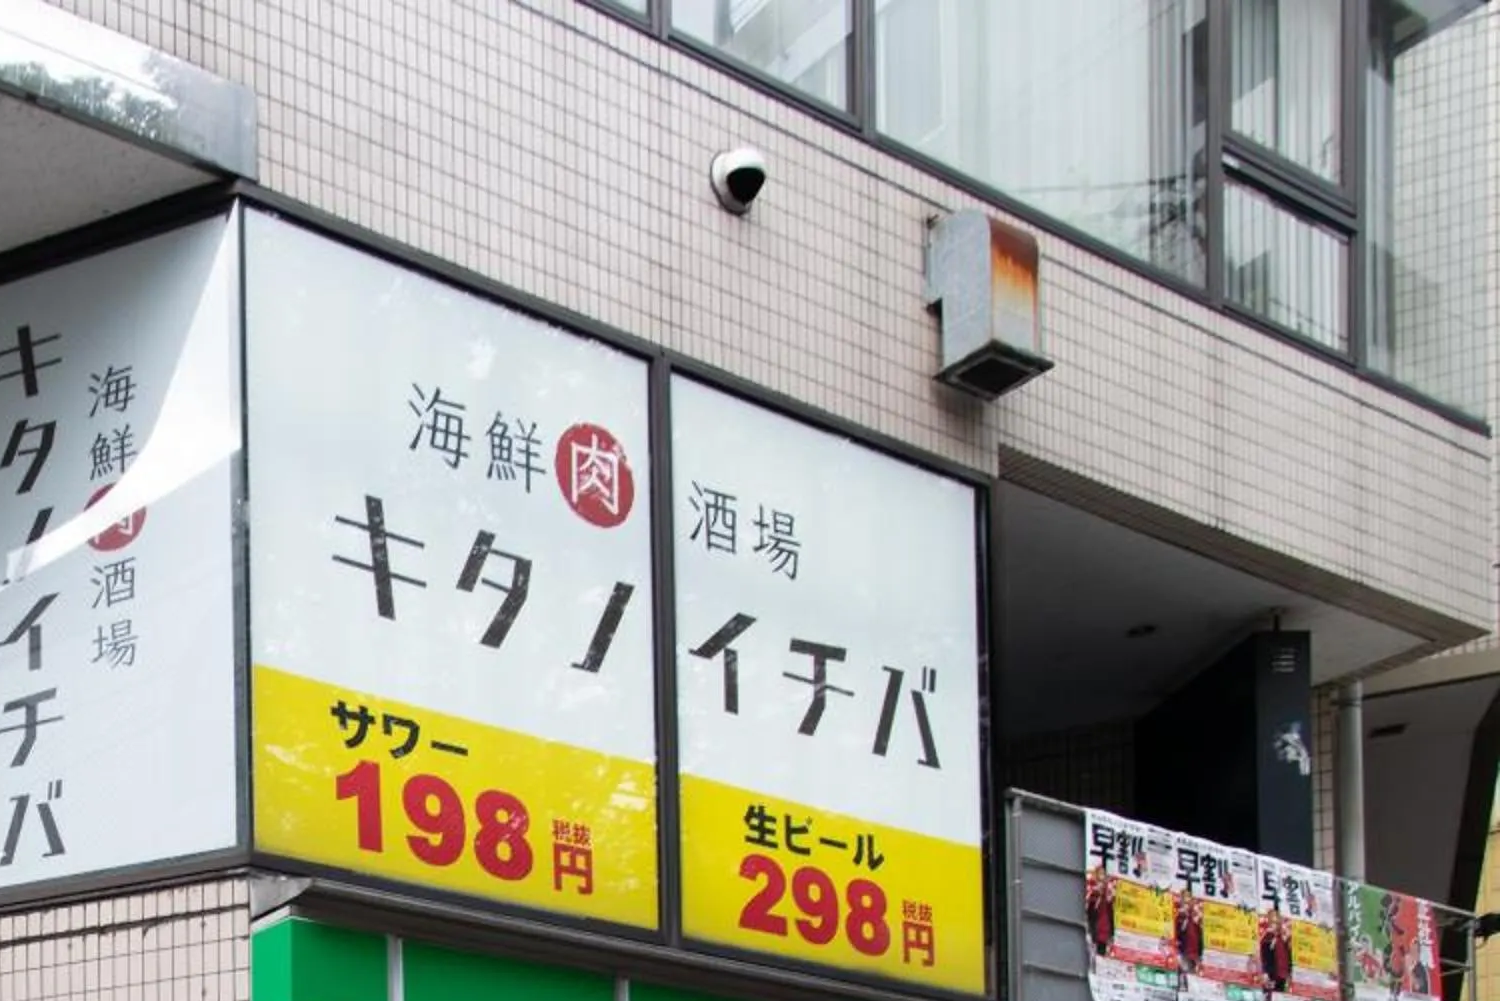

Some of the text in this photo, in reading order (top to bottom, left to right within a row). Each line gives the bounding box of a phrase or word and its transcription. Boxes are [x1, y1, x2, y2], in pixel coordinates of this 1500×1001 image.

[332, 494, 942, 770] キタノイチバ
[331, 699, 469, 760] サワー
[743, 804, 885, 873] 生ビール
